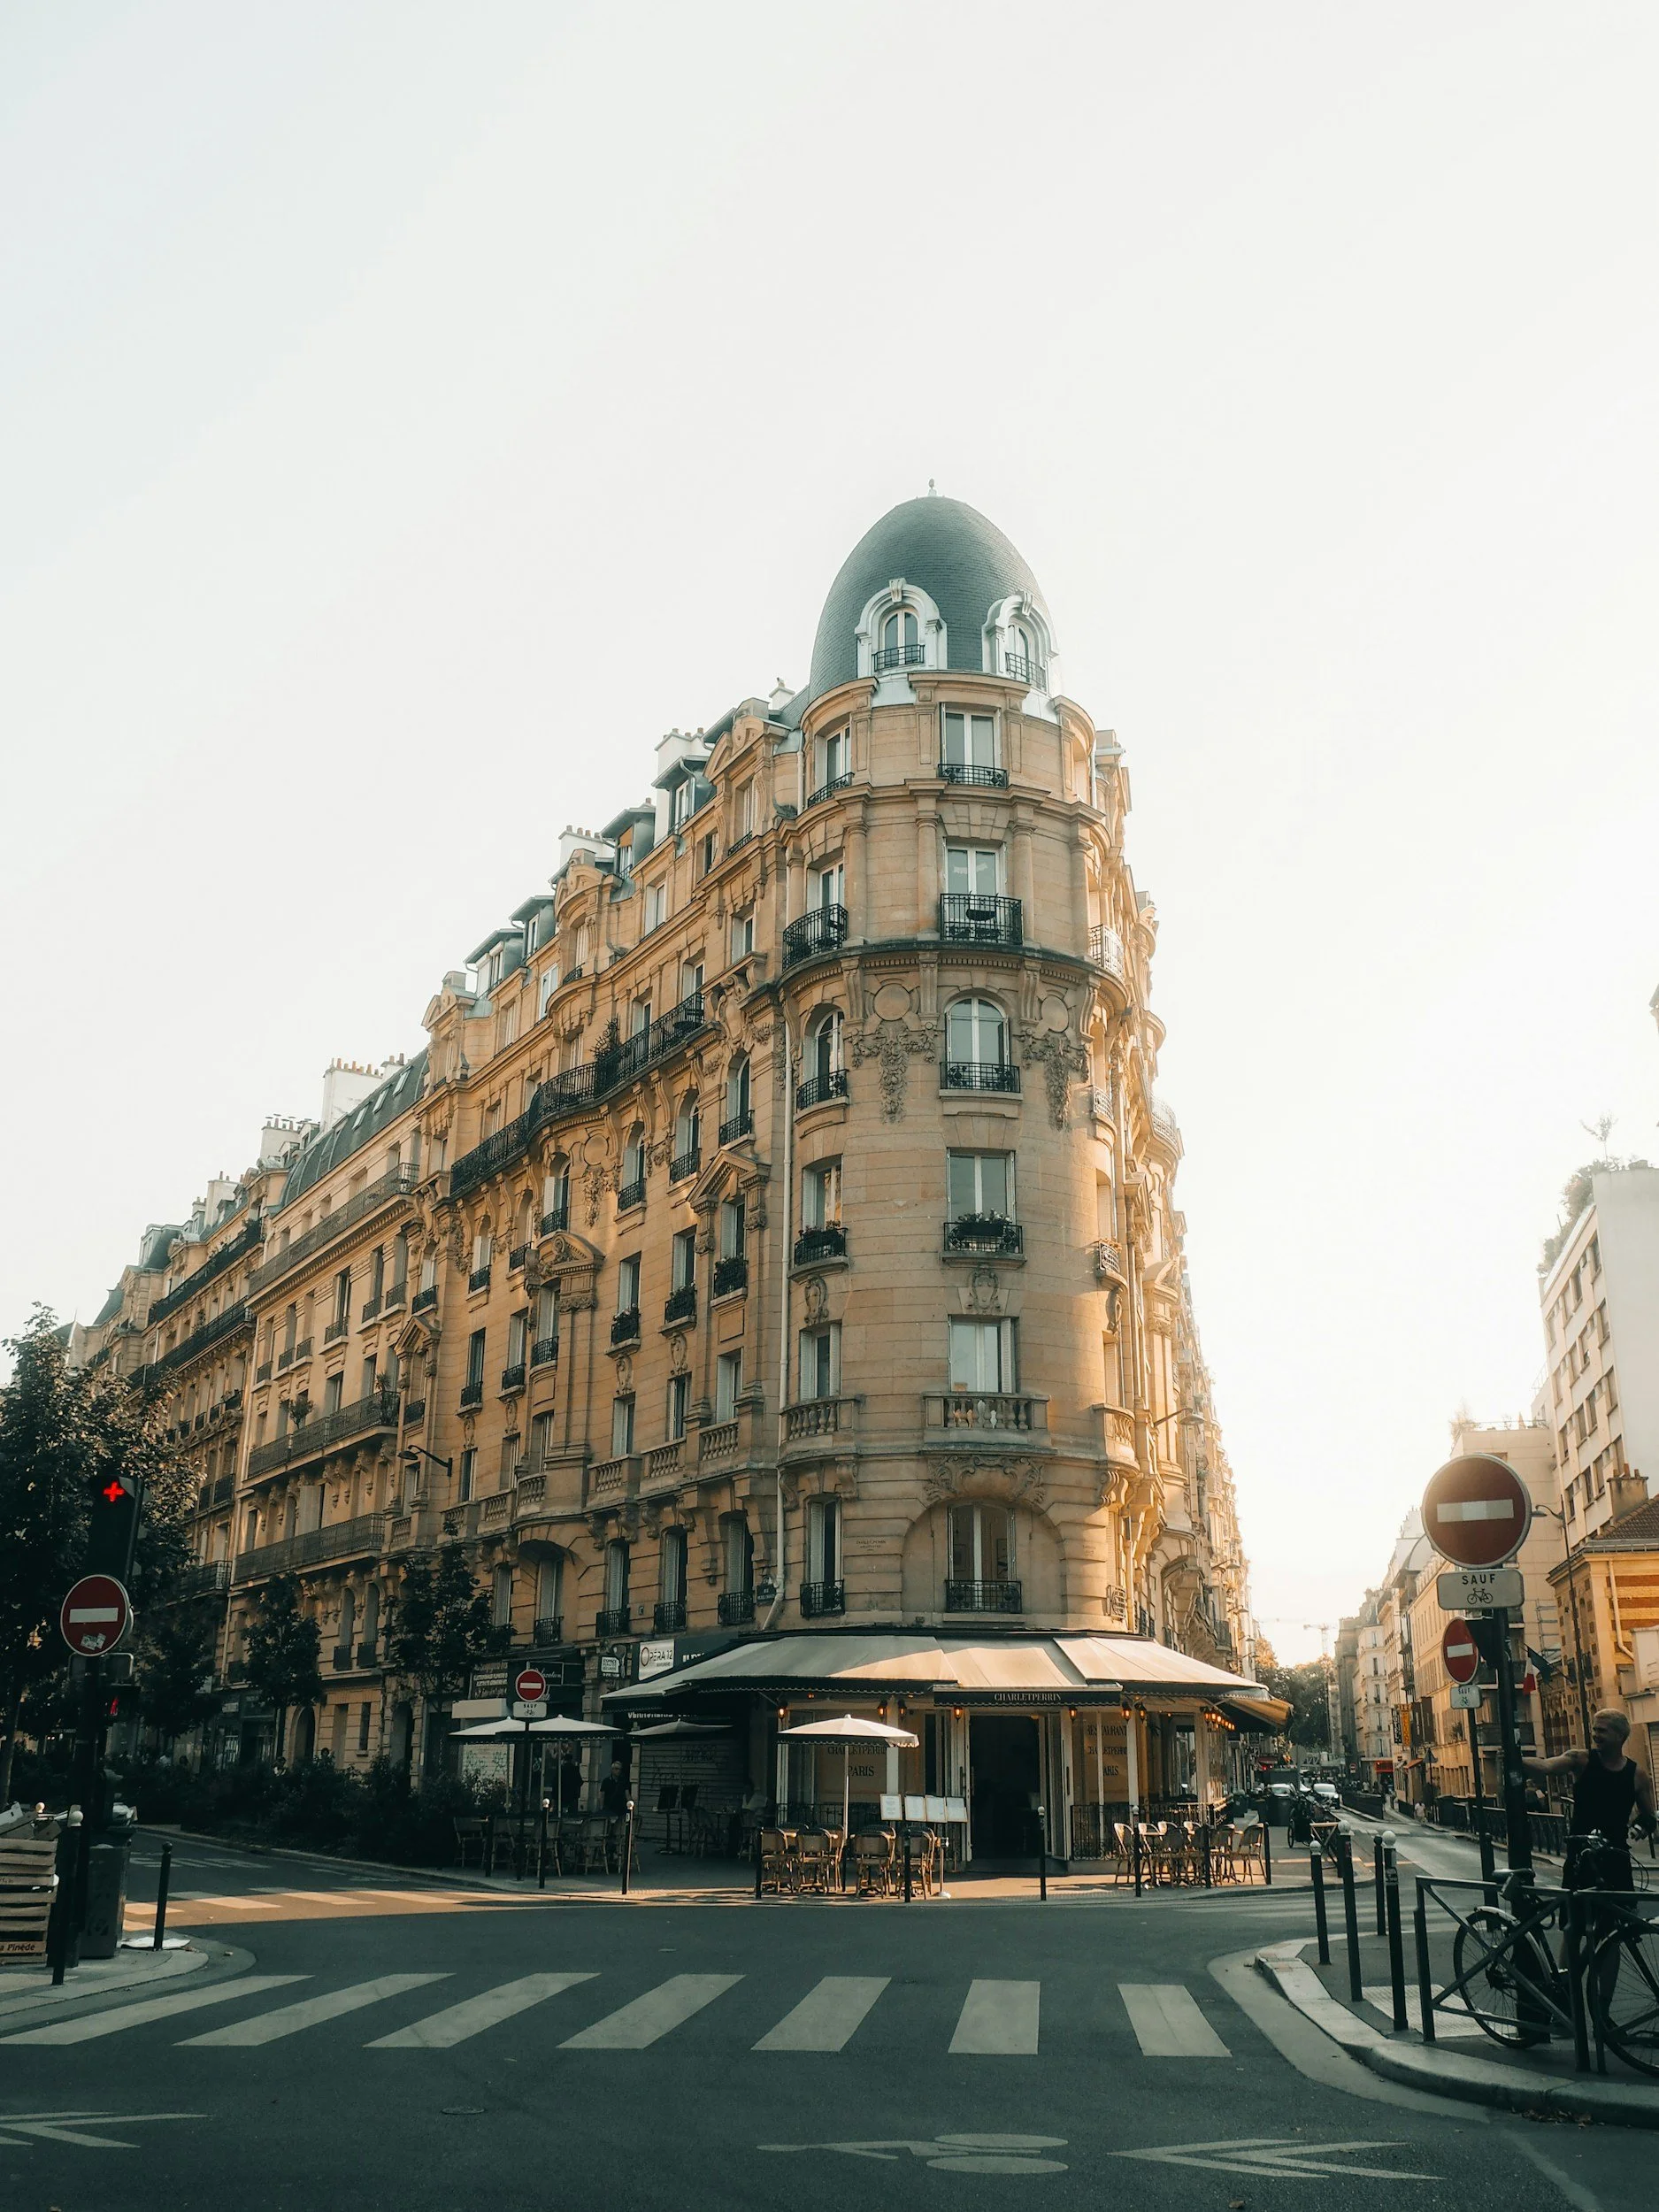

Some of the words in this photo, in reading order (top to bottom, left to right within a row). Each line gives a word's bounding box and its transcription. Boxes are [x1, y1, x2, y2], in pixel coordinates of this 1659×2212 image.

[1462, 1573, 1495, 1585] SAUF
[666, 1650, 673, 1660] 12
[1087, 1724, 1127, 1736] RESAURANT
[848, 1765, 875, 1777] PARIS
[1102, 1765, 1119, 1777] ARIS
